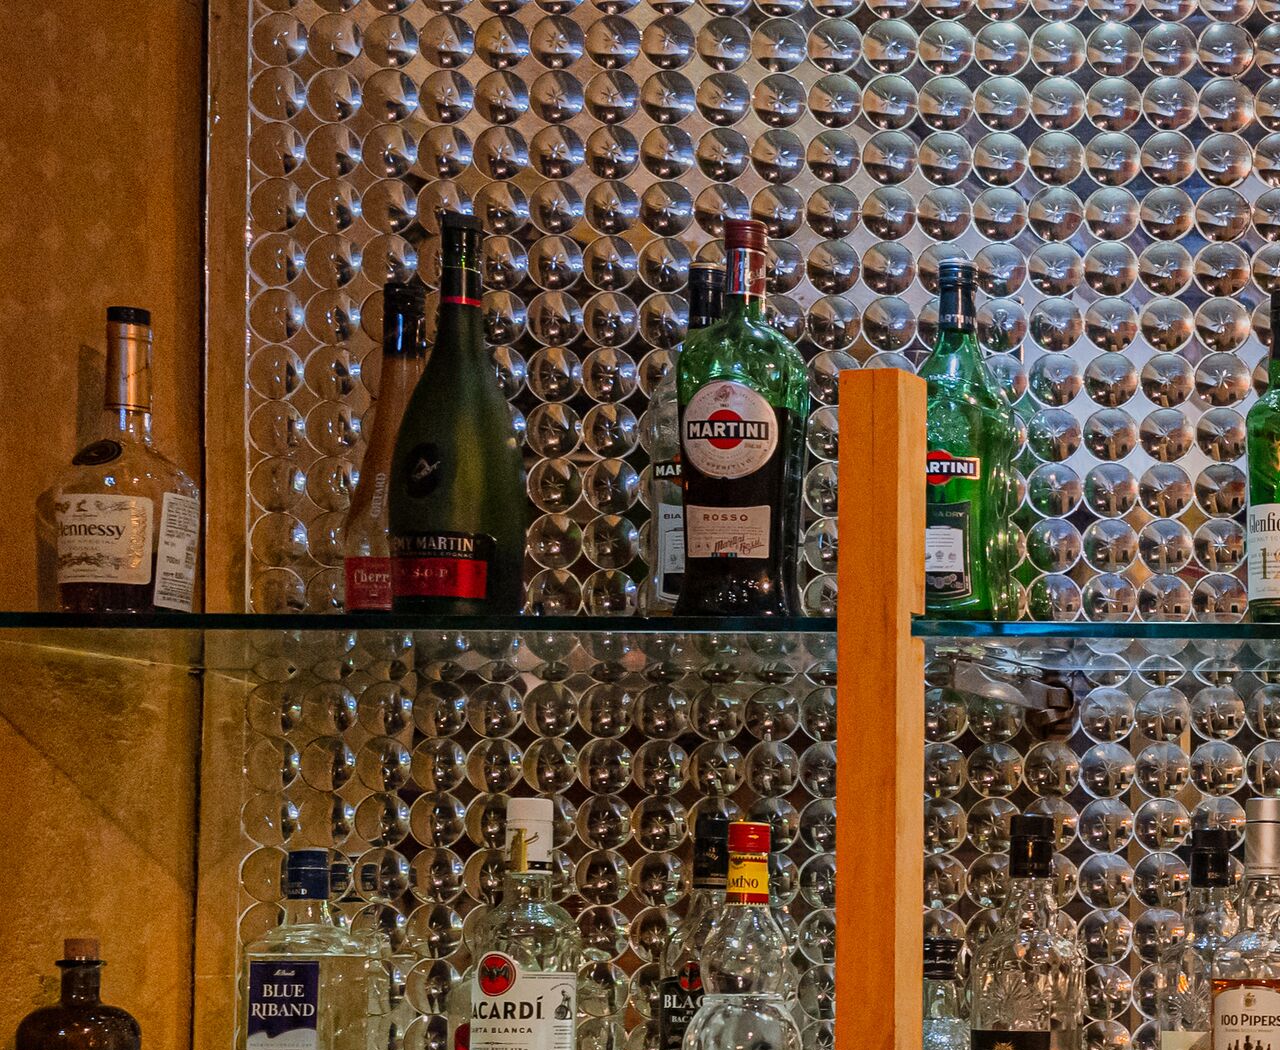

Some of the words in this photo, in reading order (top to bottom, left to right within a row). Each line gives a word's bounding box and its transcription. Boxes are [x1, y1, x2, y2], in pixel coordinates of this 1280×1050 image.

[689, 421, 766, 438] MARTINI
[926, 462, 974, 474] ARTINI
[416, 536, 474, 552] MARTIN
[263, 984, 304, 998] BLUE
[472, 996, 543, 1020] ACARDÍ
[664, 994, 703, 1009] BLAC
[251, 1003, 315, 1019] RIBAND
[1221, 1014, 1238, 1026] 100
